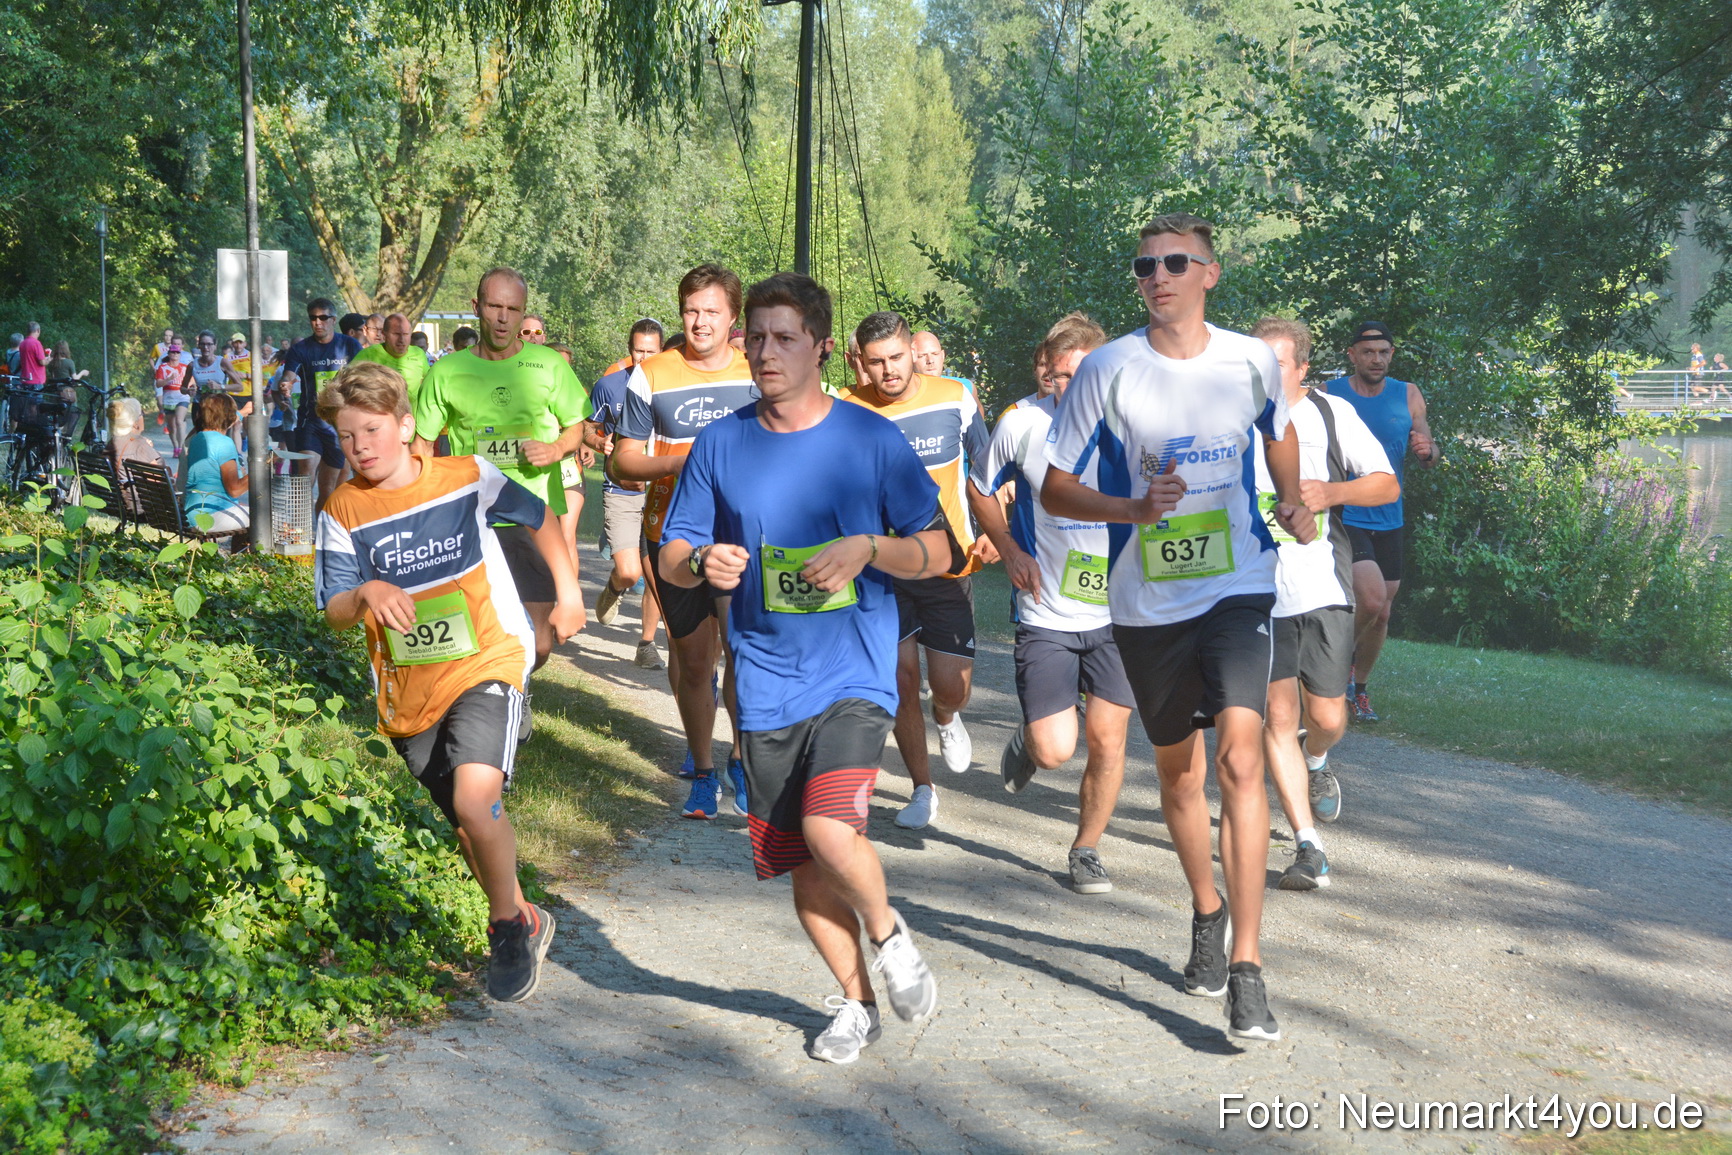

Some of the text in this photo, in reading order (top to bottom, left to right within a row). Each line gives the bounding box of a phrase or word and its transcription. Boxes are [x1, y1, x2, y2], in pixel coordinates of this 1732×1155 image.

[487, 440, 520, 456] 441
[916, 447, 942, 457] OBILE
[384, 533, 464, 569] Fischer
[1161, 535, 1210, 563] 637
[395, 550, 462, 576] AUTOMOBILE
[1170, 562, 1193, 571] Lugert
[778, 571, 826, 594] 65
[1078, 571, 1108, 591] 63
[403, 620, 454, 648] 592
[408, 643, 456, 655] Siebald Pascal
